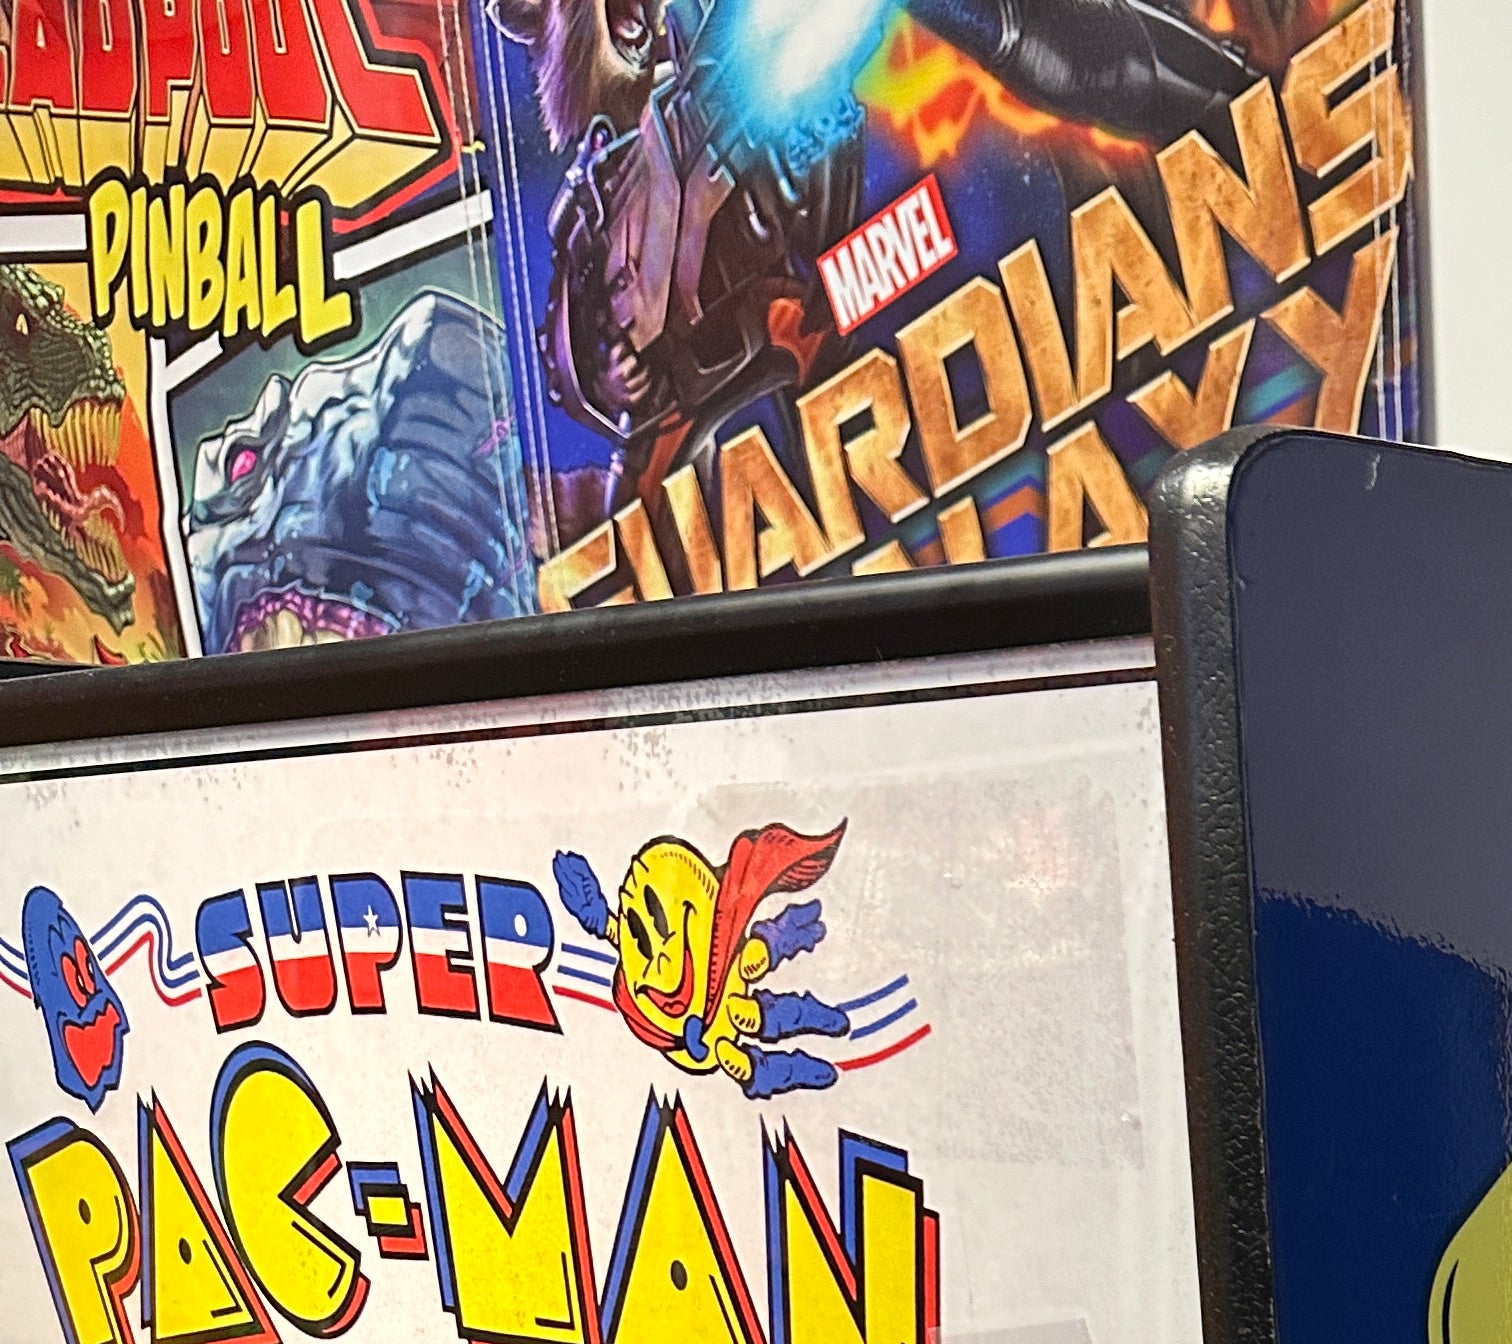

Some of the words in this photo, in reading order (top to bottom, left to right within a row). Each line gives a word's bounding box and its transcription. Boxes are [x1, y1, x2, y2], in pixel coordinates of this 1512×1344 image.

[90, 178, 352, 345] PINBALL
[820, 182, 953, 328] MARVEL
[196, 870, 564, 1035] SUPER
